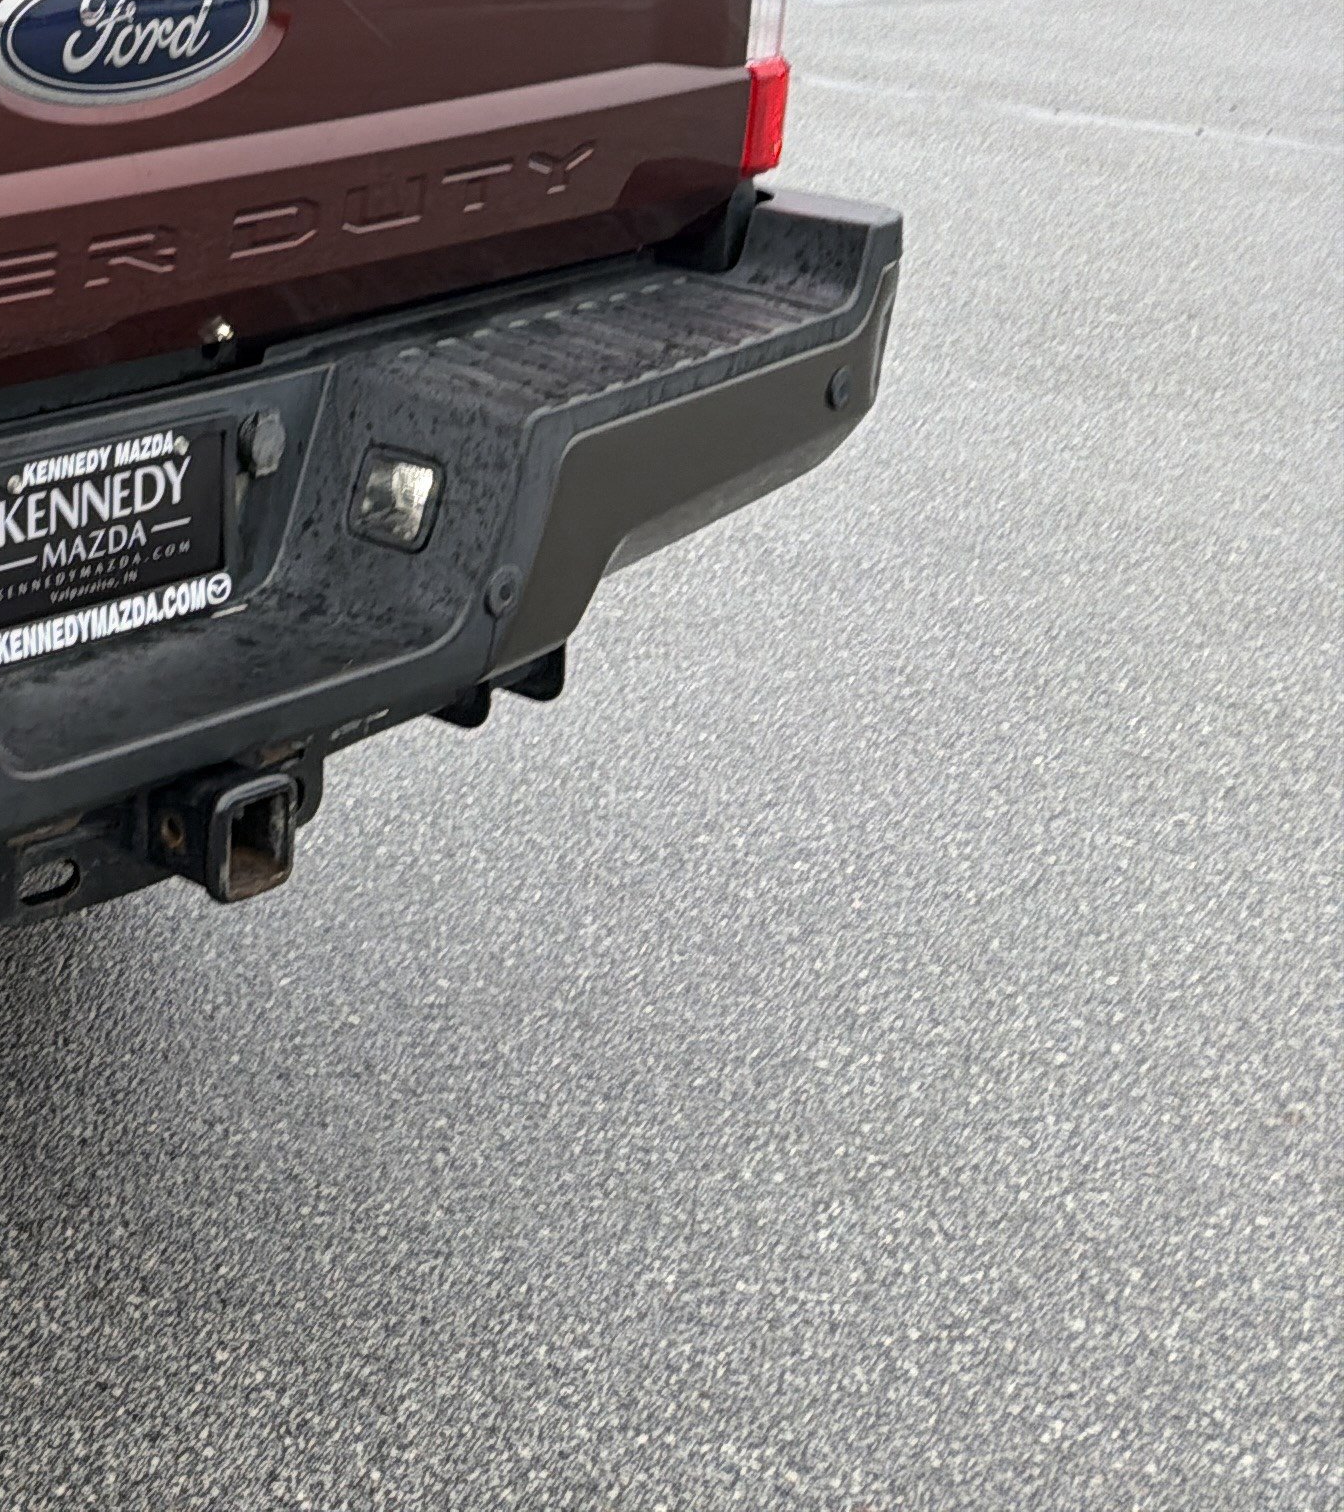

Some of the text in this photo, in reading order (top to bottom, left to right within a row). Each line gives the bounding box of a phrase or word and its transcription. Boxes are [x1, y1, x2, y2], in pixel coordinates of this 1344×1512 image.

[229, 140, 598, 261] DUTY
[20, 430, 174, 487] KENNEDY MAZDA
[41, 519, 148, 572] MAZDA
